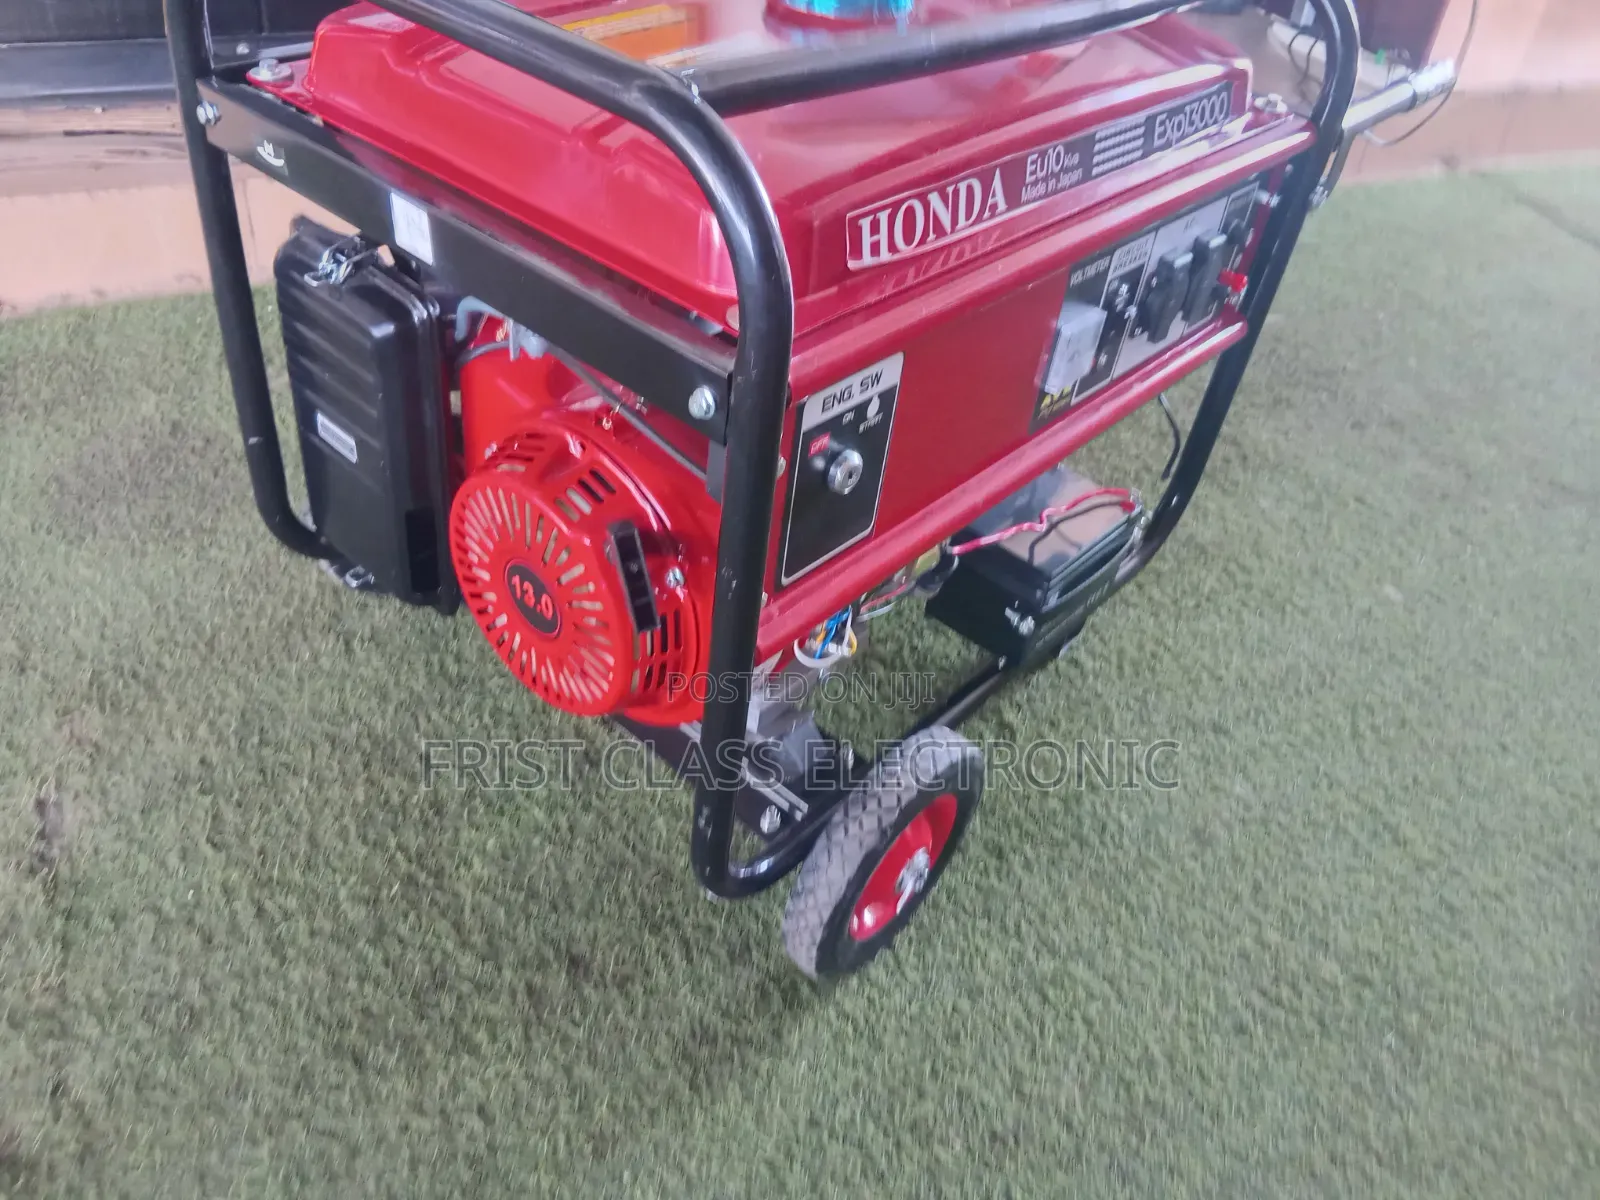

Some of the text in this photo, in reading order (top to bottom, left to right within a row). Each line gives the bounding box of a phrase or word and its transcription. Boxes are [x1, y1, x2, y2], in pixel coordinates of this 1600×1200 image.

[1153, 91, 1228, 148] Exp13000
[1025, 144, 1065, 184] Eu10
[1021, 167, 1083, 204] Made in Japan
[858, 167, 1009, 265] HONDA
[1070, 255, 1111, 288] VOLTMETER
[859, 368, 884, 397] SW
[810, 435, 829, 455] OFF
[512, 575, 553, 620] 13.0
